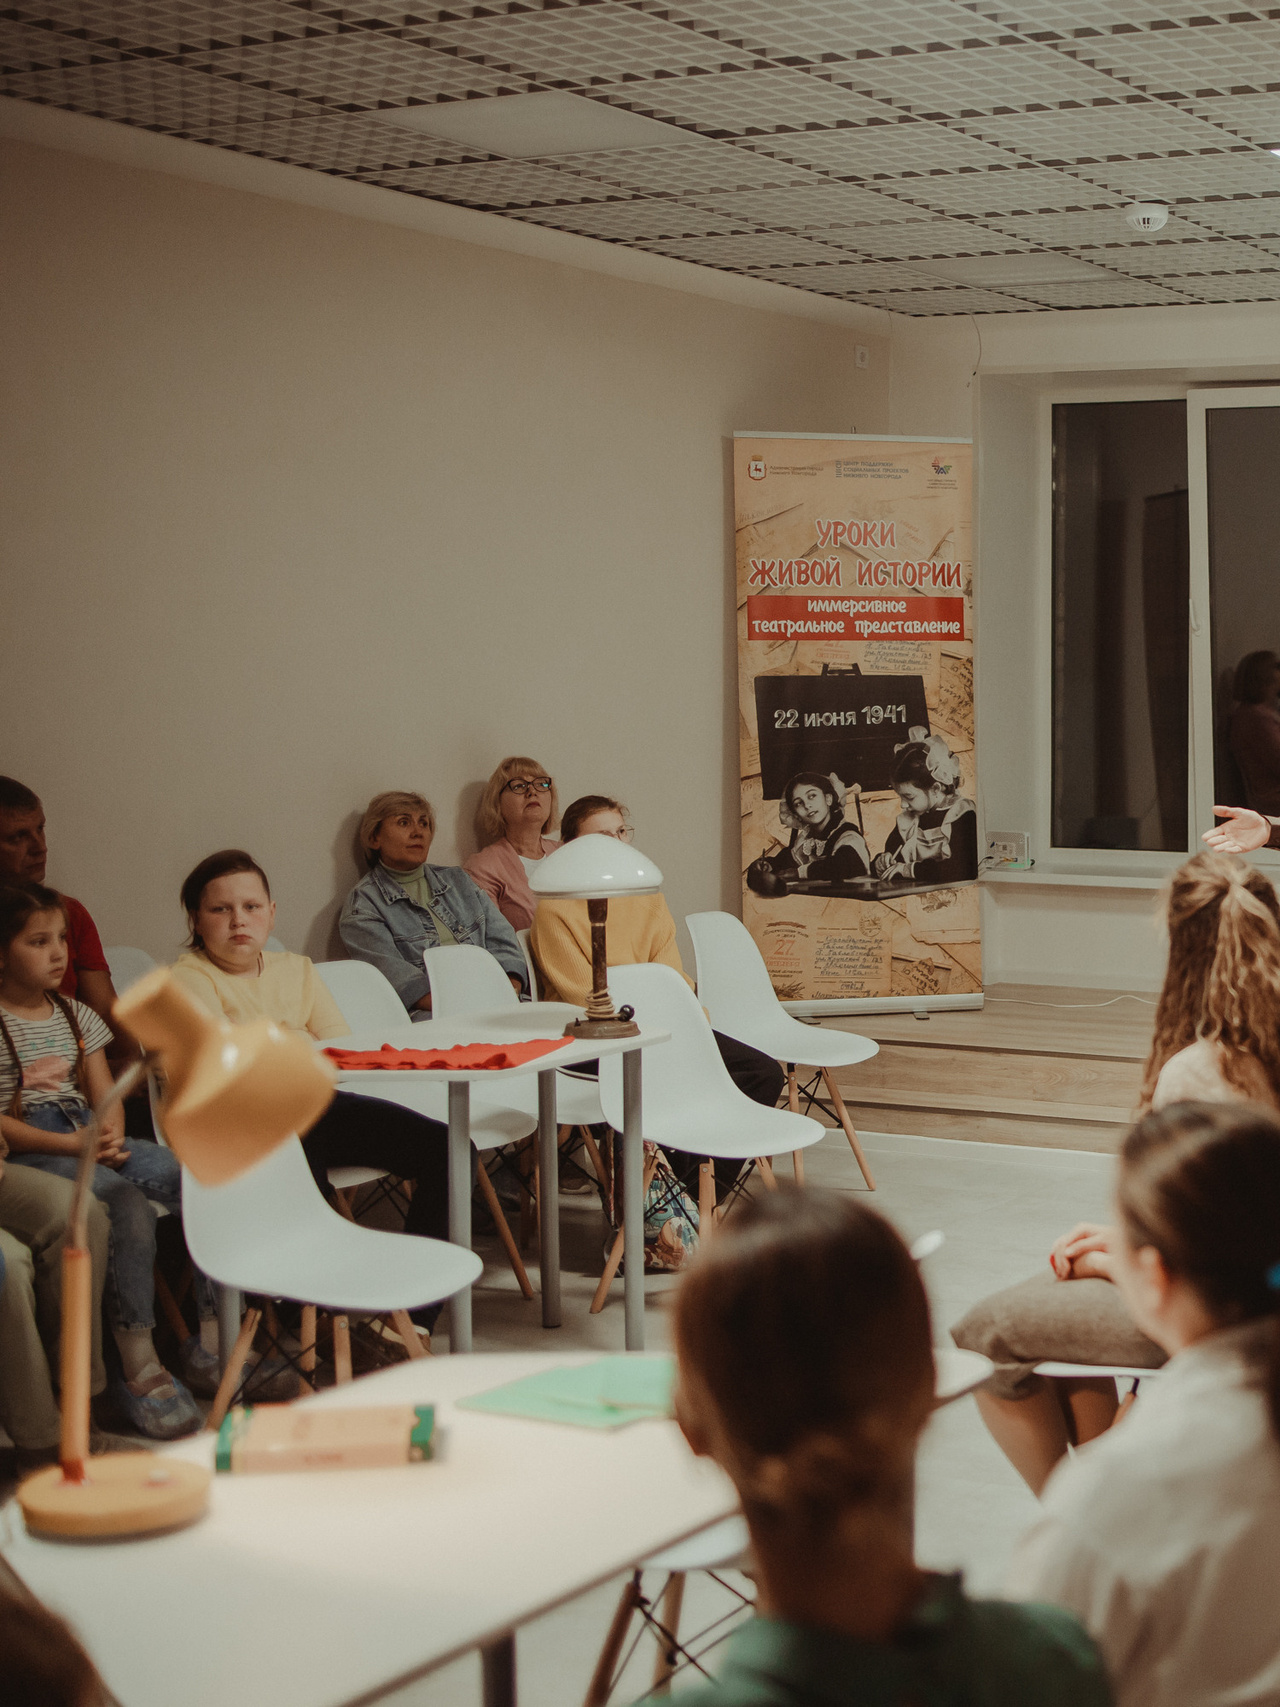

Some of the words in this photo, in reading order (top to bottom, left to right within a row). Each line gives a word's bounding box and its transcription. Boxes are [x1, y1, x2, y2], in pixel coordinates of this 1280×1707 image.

[815, 518, 897, 549] УРОКИ
[747, 556, 842, 588] ЖИВОЙ
[856, 560, 963, 589] ИСТОРИИ
[807, 599, 907, 617] иммерсивное
[752, 618, 845, 637] театральное
[854, 619, 961, 638] представление
[773, 709, 800, 729] 22
[804, 710, 857, 728] июня
[861, 704, 908, 725] 1941
